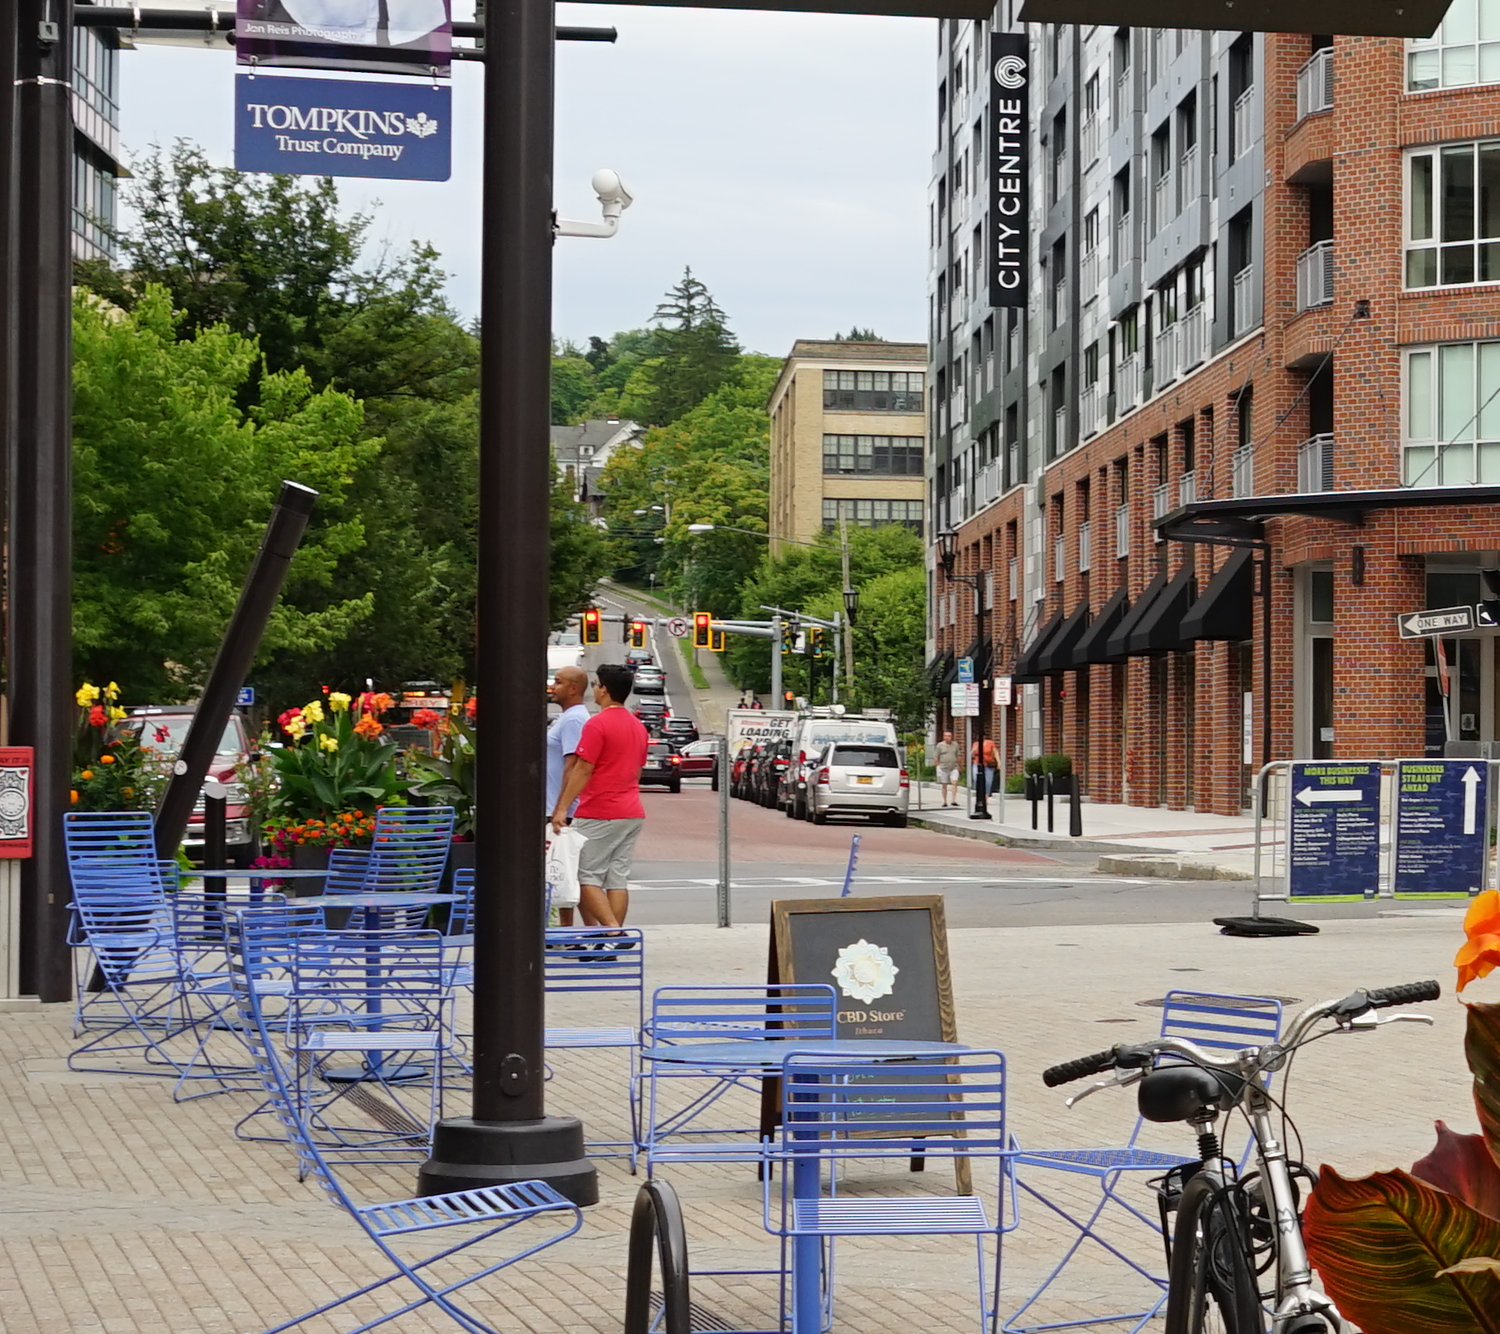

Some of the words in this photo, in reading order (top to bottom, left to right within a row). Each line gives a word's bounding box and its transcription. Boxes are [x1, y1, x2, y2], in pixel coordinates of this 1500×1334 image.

[267, 24, 289, 36] Reis
[247, 103, 405, 140] TOMPKINS
[275, 134, 321, 153] Trust
[323, 138, 404, 161] Company
[998, 98, 1021, 216] CENTRE
[998, 222, 1020, 289] CITY
[1417, 617, 1438, 629] ONE
[1444, 614, 1466, 625] WAY
[770, 718, 792, 728] GET
[740, 727, 790, 739] LOADING
[1320, 777, 1336, 785] THIS
[1337, 776, 1355, 785] WAY
[1402, 775, 1442, 783] STRAIGHT
[836, 1011, 867, 1024] CBD
[869, 1009, 904, 1022] Store
